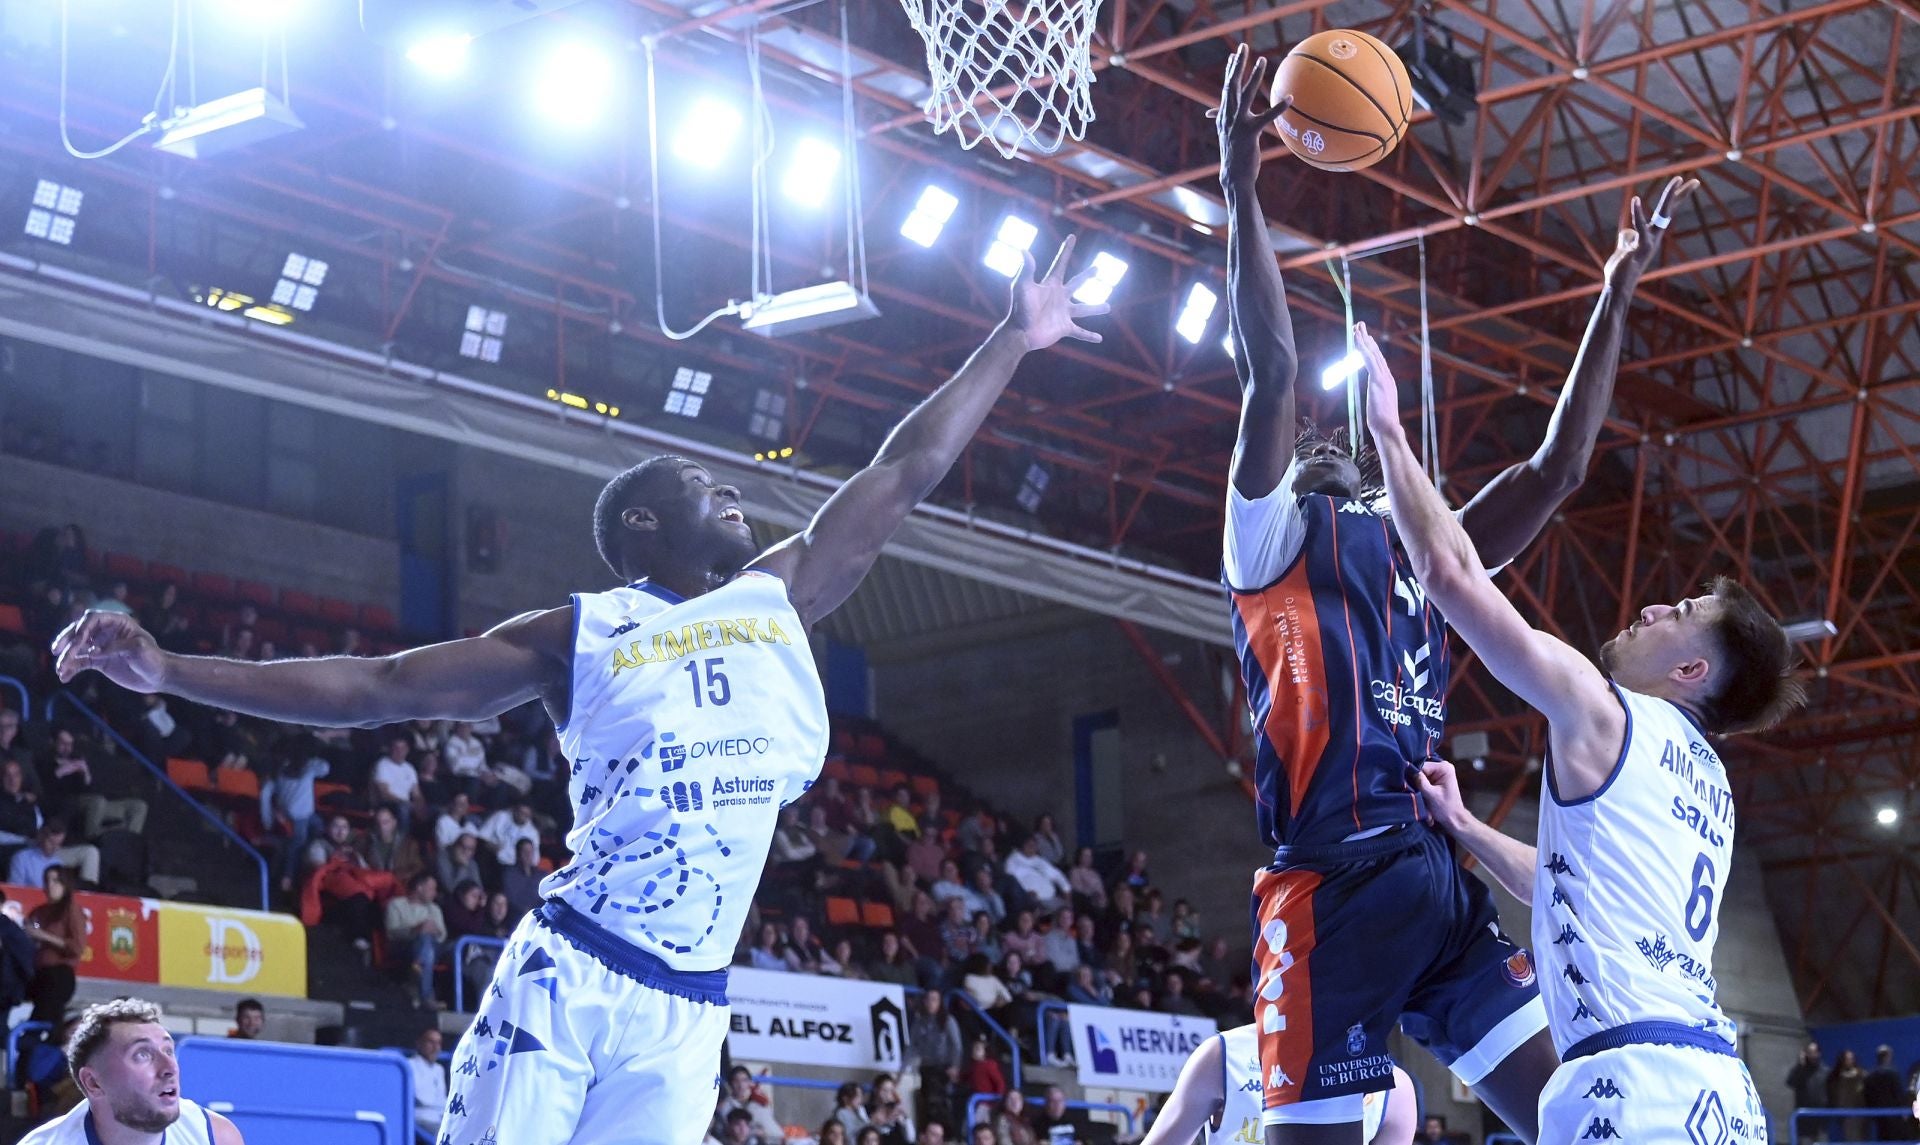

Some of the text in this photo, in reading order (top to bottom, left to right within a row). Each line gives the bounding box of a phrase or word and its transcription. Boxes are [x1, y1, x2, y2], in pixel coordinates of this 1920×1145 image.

[612, 618, 791, 677] ALIMERKA
[1285, 596, 1309, 683] RENACIMIENTO
[684, 657, 731, 708] 15
[1377, 707, 1412, 726] urgos
[691, 737, 769, 759] OVIEDO
[712, 776, 775, 795] Asturias
[1685, 852, 1715, 942] 6
[730, 1014, 853, 1044] EL ALFOZ
[1321, 1076, 1337, 1087] DE
